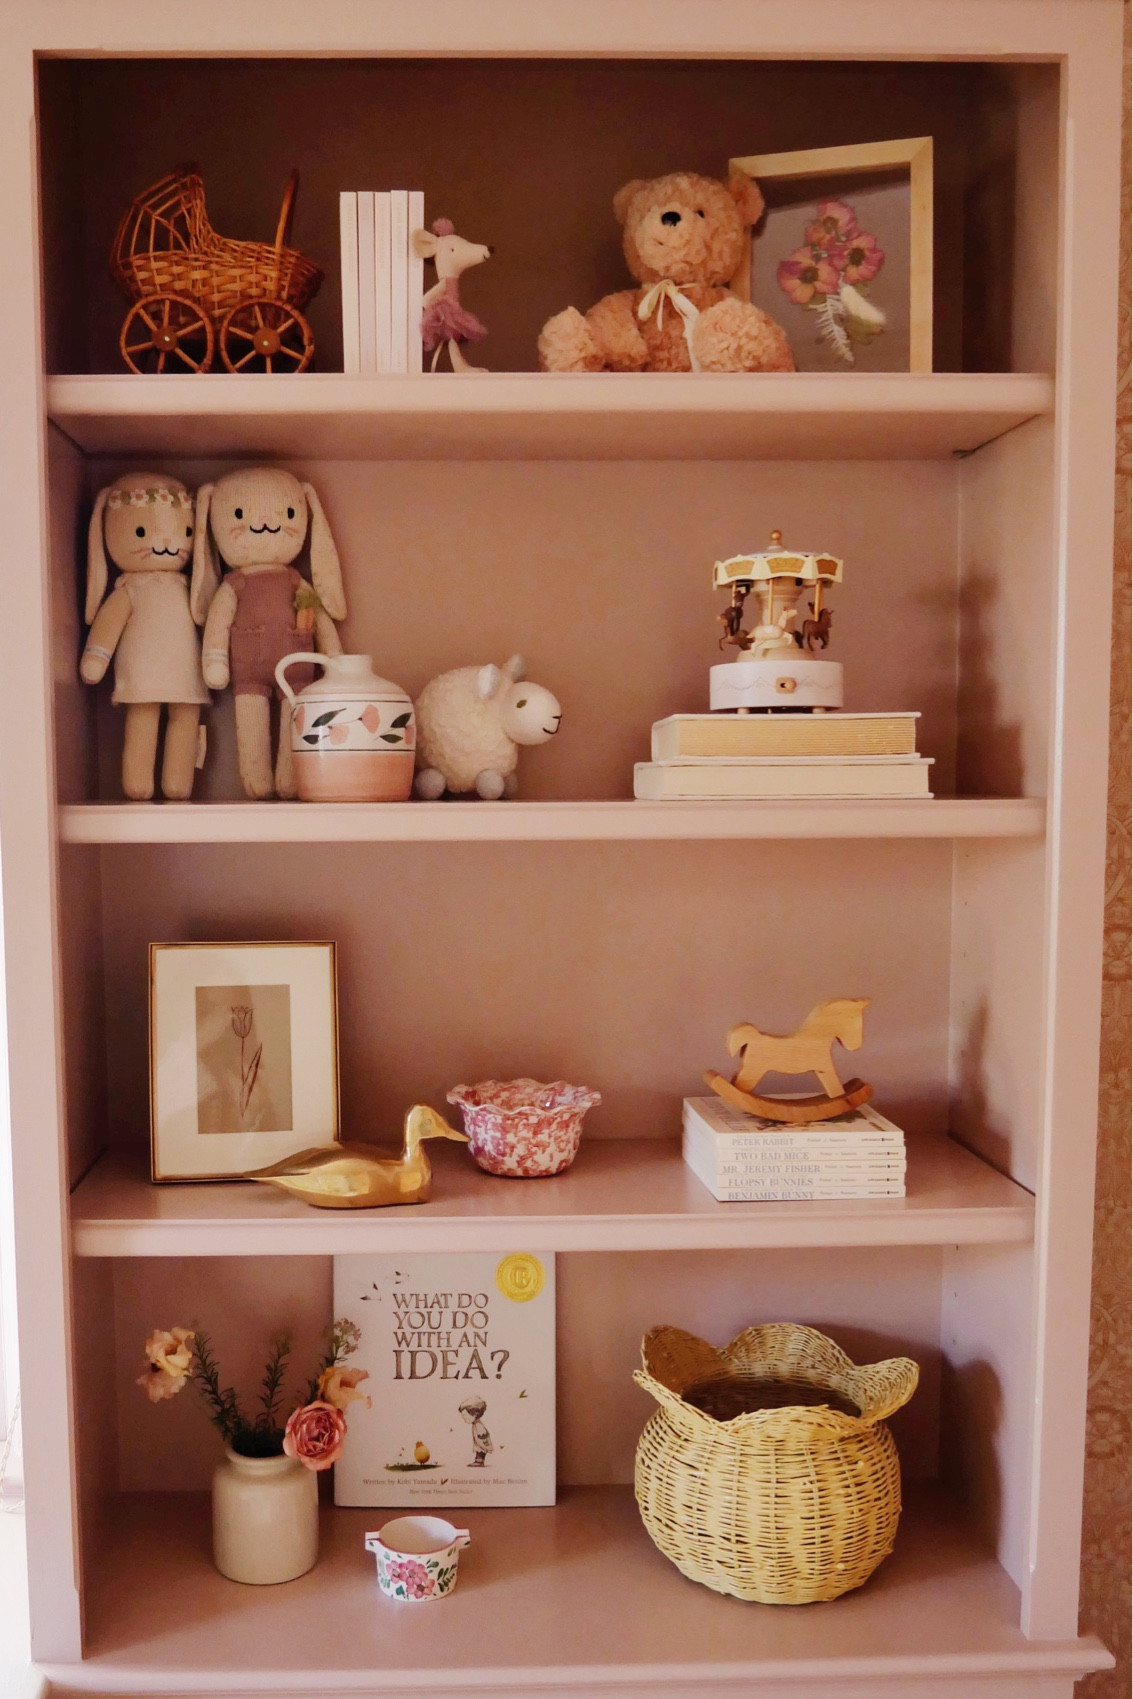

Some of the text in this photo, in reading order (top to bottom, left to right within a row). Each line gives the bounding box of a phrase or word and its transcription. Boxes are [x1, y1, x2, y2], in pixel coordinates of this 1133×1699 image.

[731, 1138, 794, 1146] PETER RABBIT
[734, 1152, 758, 1161] TWO
[761, 1152, 781, 1161] BAD
[784, 1151, 810, 1160] MICE
[743, 1165, 781, 1174] JEREMY
[785, 1164, 821, 1173] FISHER
[728, 1178, 766, 1187] FLOPSY
[770, 1177, 814, 1186] BUNNIES
[728, 1191, 778, 1200] BENJAMIN
[781, 1191, 816, 1199] BUNNY
[392, 1293, 489, 1309] WHAT DO
[392, 1311, 489, 1330] YOU DO
[393, 1331, 489, 1348] WITH AN
[392, 1348, 510, 1380] IDEA?
